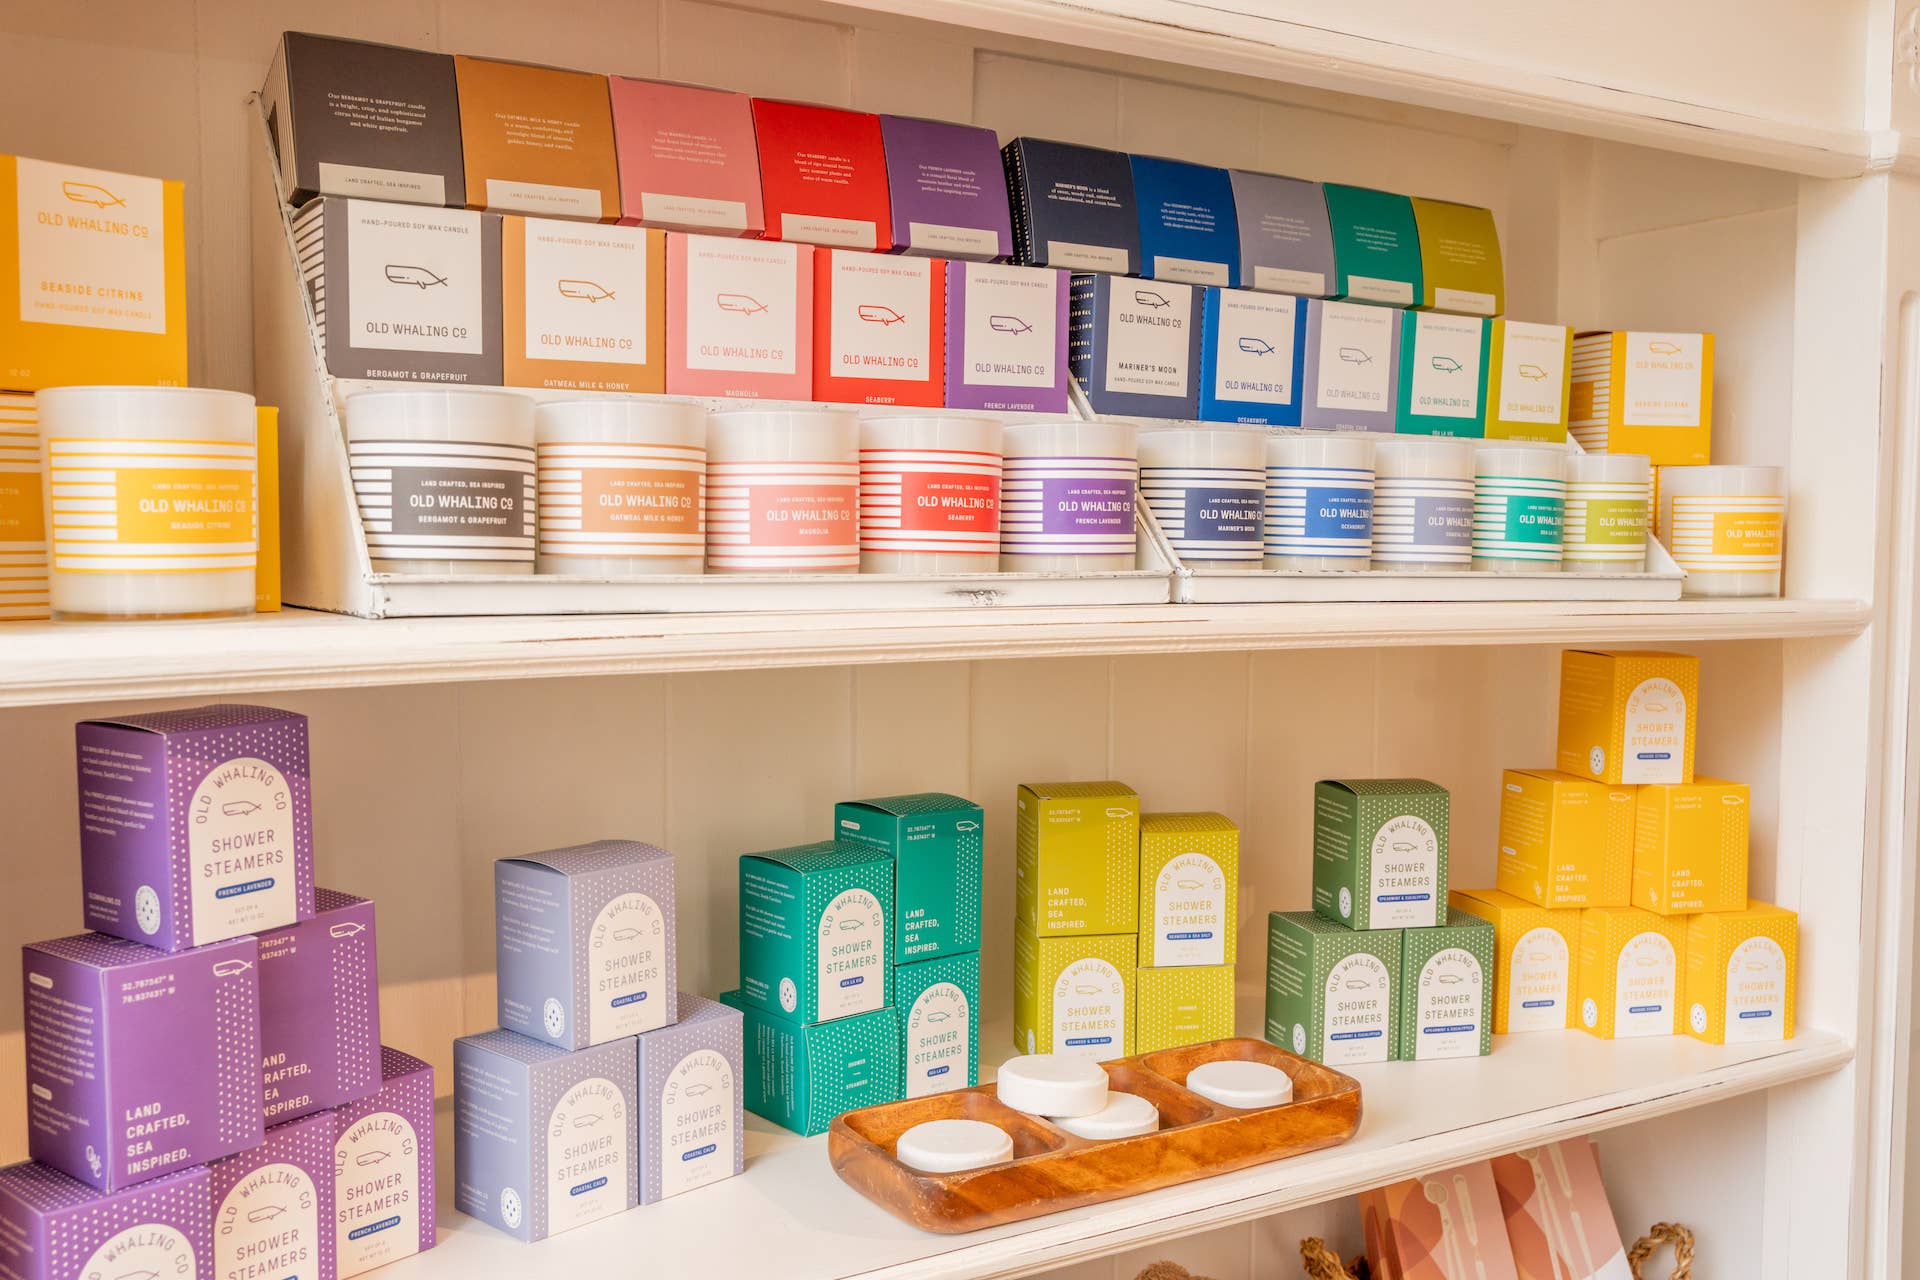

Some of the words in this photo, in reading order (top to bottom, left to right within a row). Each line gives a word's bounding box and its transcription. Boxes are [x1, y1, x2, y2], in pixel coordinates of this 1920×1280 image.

[36, 212, 63, 229] OLD
[65, 216, 129, 237] WHALING
[361, 218, 410, 228] HAND-POURED
[443, 225, 468, 233] CANDLE
[40, 282, 92, 296] SEASIDE
[97, 288, 143, 300] CITRINE
[1119, 313, 1134, 323] OLD
[1135, 315, 1170, 326] WHALING
[366, 322, 388, 334] OLD
[392, 323, 448, 337] WHALING
[540, 334, 561, 345] OLD
[564, 335, 615, 348] WHALING
[700, 344, 719, 357] OLD
[722, 346, 768, 359] WHALING
[842, 354, 860, 364] OLD
[862, 355, 904, 366] WHALING
[975, 362, 991, 372] OLD
[993, 363, 1031, 374] WHALING
[1118, 362, 1155, 371] MARINER'S
[1158, 365, 1176, 373] MOON
[366, 369, 408, 379] BERGAMOT
[420, 371, 466, 381] GRAPEFRUIT
[543, 380, 576, 388] OATMEAL
[576, 381, 595, 389] MILK
[605, 382, 628, 390] HONEY
[1225, 380, 1238, 389] OLD
[1240, 381, 1272, 391] WHALING
[724, 390, 759, 398] MAGNOLIA
[864, 396, 896, 404] SEABERRY
[984, 402, 1007, 410] FRENCH
[1006, 403, 1034, 411] LAVENDER
[139, 498, 169, 512] OLD
[173, 498, 233, 512] WHALING
[409, 495, 434, 507] OLD
[438, 495, 497, 509] WHALING
[599, 494, 622, 506] OLD
[626, 495, 678, 508] WHALING
[917, 495, 938, 506] OLD
[940, 496, 984, 508] WHALING
[1058, 500, 1078, 511] OLD
[1081, 501, 1121, 511] WHALING
[418, 515, 457, 523] BERGAMOT
[467, 516, 506, 524] GRAPEFRUIT
[1199, 509, 1218, 519] OLD
[1220, 509, 1255, 519] WHALING
[195, 794, 213, 824] OLD
[213, 766, 275, 789] WHALING
[274, 791, 287, 810] CO
[211, 829, 275, 853] SHOWER
[1375, 836, 1387, 854] OLD
[1389, 820, 1427, 835] WHALING
[1425, 840, 1434, 852] CO
[204, 850, 284, 878] STEAMERS
[1384, 863, 1425, 873] SHOWER
[1160, 874, 1171, 892] OLD
[1172, 858, 1213, 874] WHALING
[1212, 878, 1222, 890] CO
[218, 886, 242, 898] FRENCH
[243, 880, 272, 893] LAVENDER
[1378, 877, 1430, 888] STEAMERS
[1048, 888, 1070, 896] LAND
[1048, 898, 1087, 907] CRAFTED,
[1169, 901, 1213, 911] SHOWER
[822, 915, 834, 936] OLD
[836, 895, 873, 911] WHALING
[871, 913, 880, 927] CO
[905, 909, 925, 918] LAND
[1048, 910, 1063, 918] SEA
[1162, 915, 1217, 926] STEAMERS
[593, 924, 607, 949] OLD
[607, 900, 651, 920] WHALING
[649, 919, 662, 936] CO
[905, 919, 940, 931] CRAFTED,
[1047, 920, 1087, 929] INSPIRED.
[905, 933, 919, 942] SEA
[832, 940, 872, 957] SHOWER
[904, 943, 940, 955] INSPIRED.
[604, 951, 652, 972] SHOWER
[826, 955, 877, 974] STEAMERS
[599, 968, 658, 991] STEAMERS
[1431, 995, 1470, 1005] SHOWER
[1425, 1008, 1475, 1020] STEAMERS
[125, 1102, 162, 1121] LAND
[676, 1104, 721, 1127] SHOWER
[126, 1115, 190, 1139] CRAFTED,
[670, 1120, 727, 1146] STEAMERS
[126, 1141, 153, 1157] SEA
[334, 1148, 348, 1176] OLD
[349, 1119, 403, 1144] WHALING
[401, 1136, 413, 1156] CO
[126, 1148, 191, 1175] INSPIRED.
[346, 1172, 402, 1201] SHOWER
[338, 1190, 410, 1223] STEAMERS
